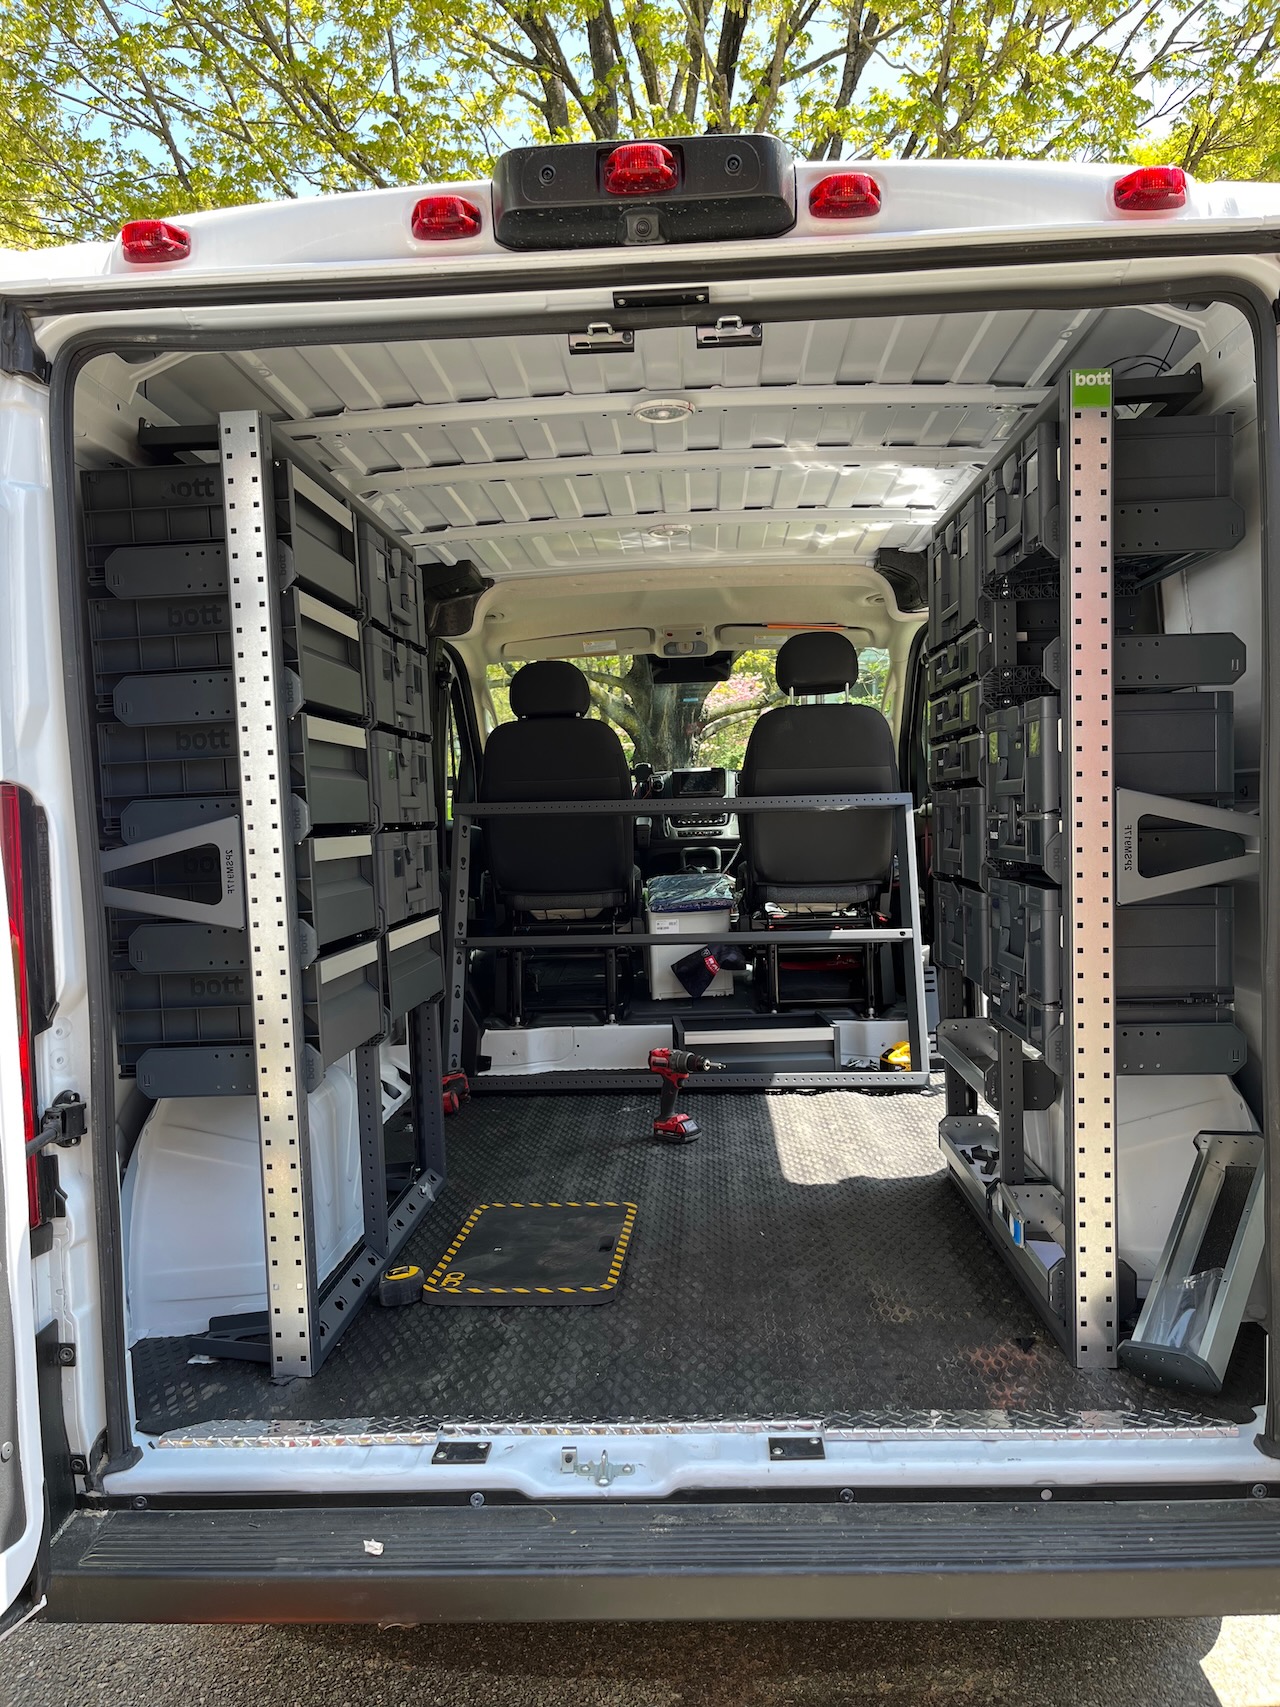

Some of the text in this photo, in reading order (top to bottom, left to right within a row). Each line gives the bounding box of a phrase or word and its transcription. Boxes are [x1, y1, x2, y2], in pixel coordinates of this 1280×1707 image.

[1075, 372, 1111, 386] bott
[279, 553, 287, 576] bott
[167, 604, 223, 627] bott
[286, 680, 294, 703] bott
[175, 728, 231, 751] bott
[293, 807, 301, 830] bott
[183, 853, 218, 874] bo
[300, 933, 308, 955] bott
[189, 976, 245, 997] bott
[1054, 1039, 1063, 1062] bott
[306, 1057, 315, 1080] bott
